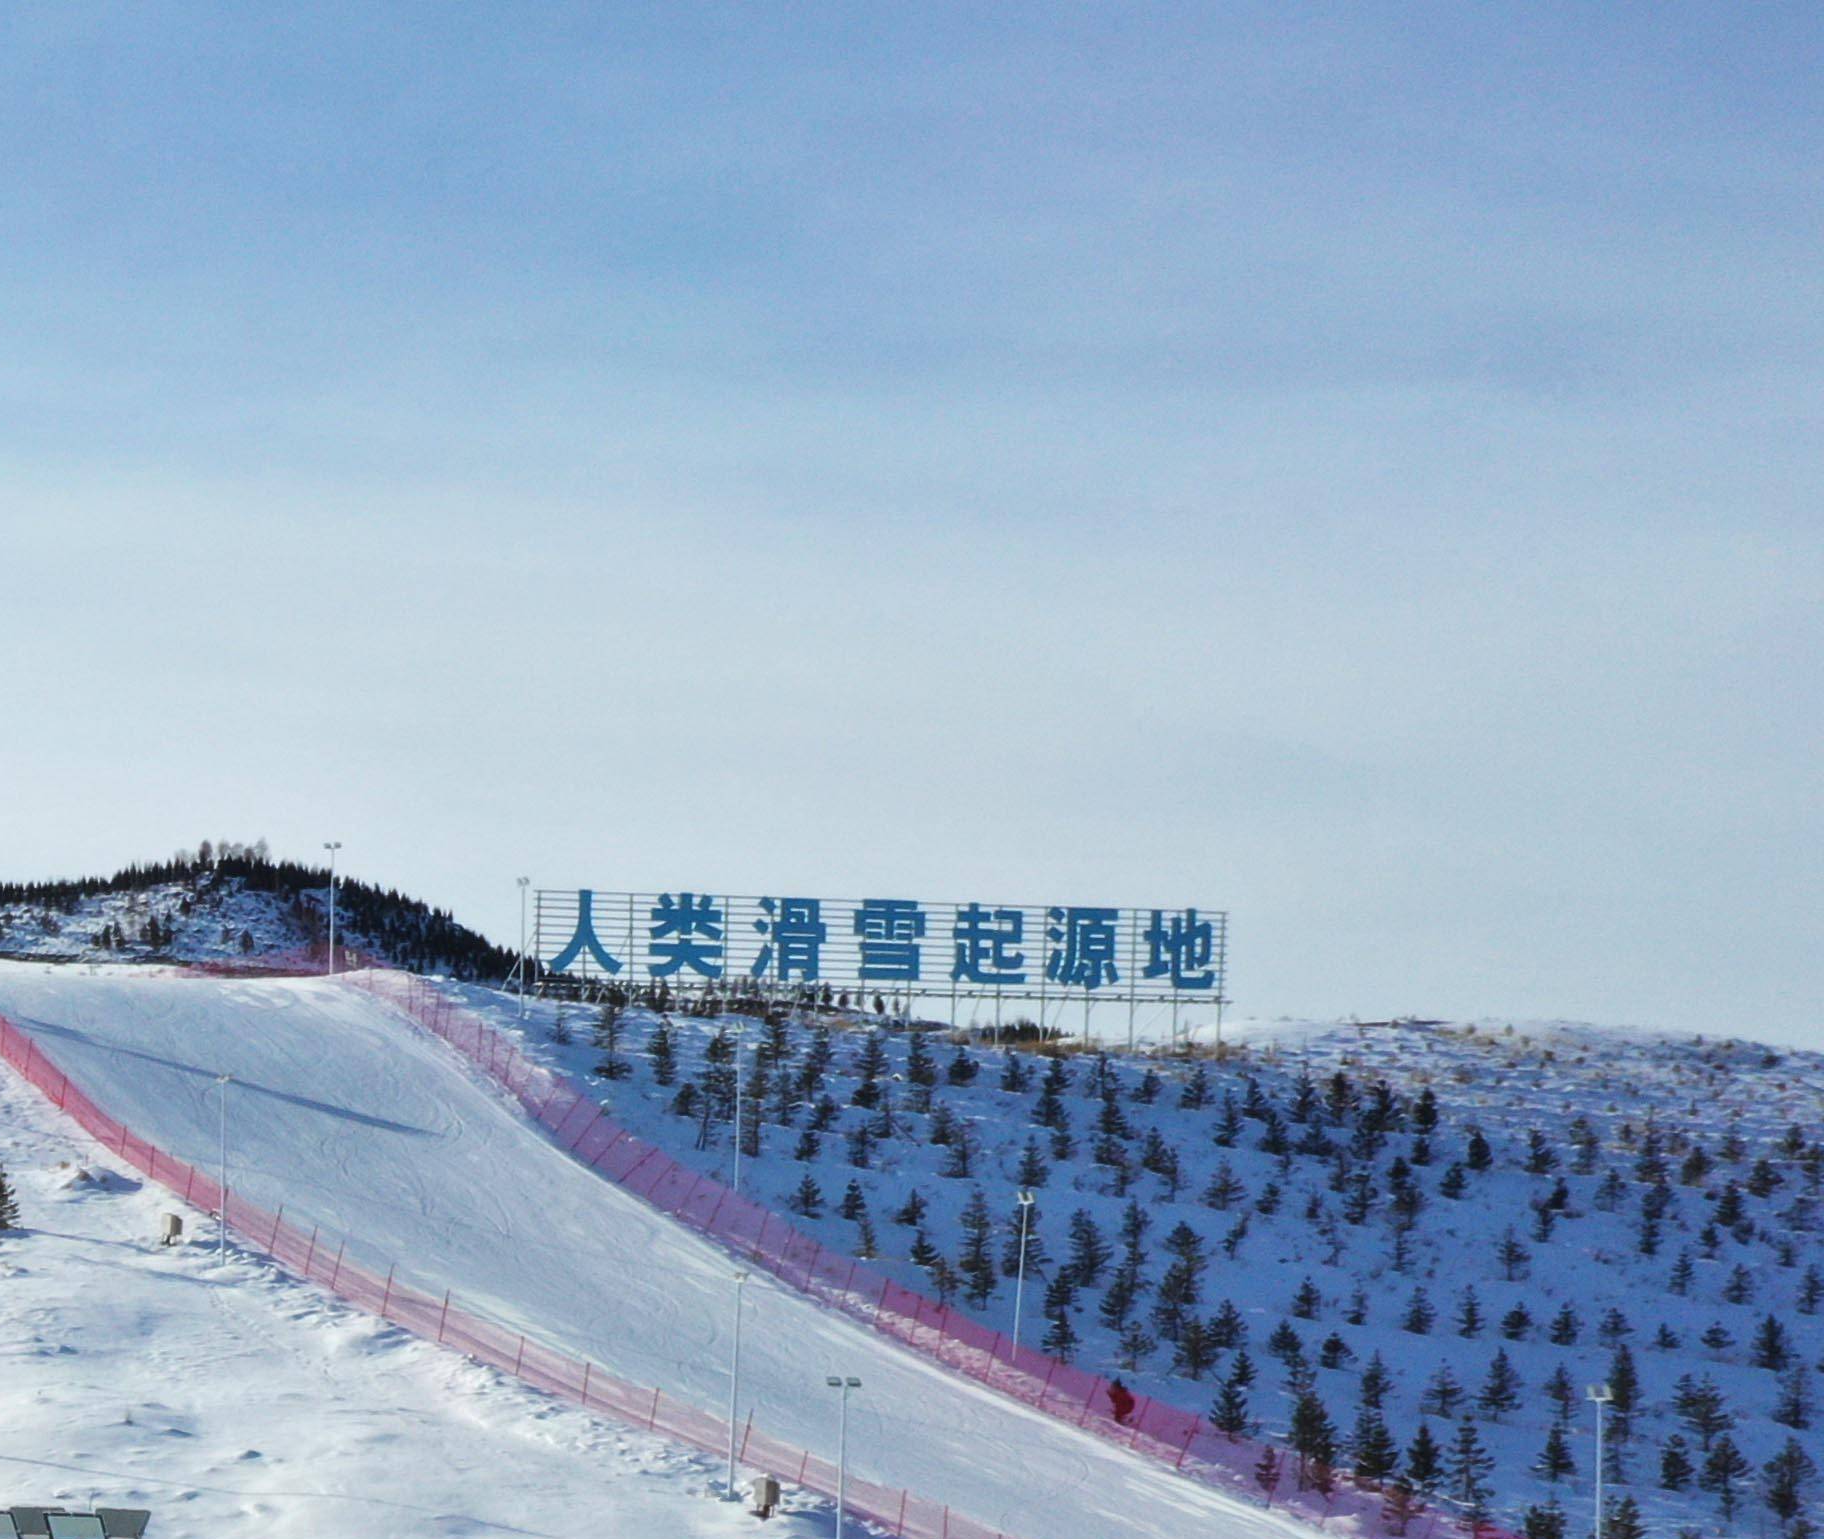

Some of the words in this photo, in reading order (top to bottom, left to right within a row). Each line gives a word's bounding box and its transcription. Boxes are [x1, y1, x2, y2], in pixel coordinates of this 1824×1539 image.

[548, 889, 1215, 989] 人类滑雪起源地
